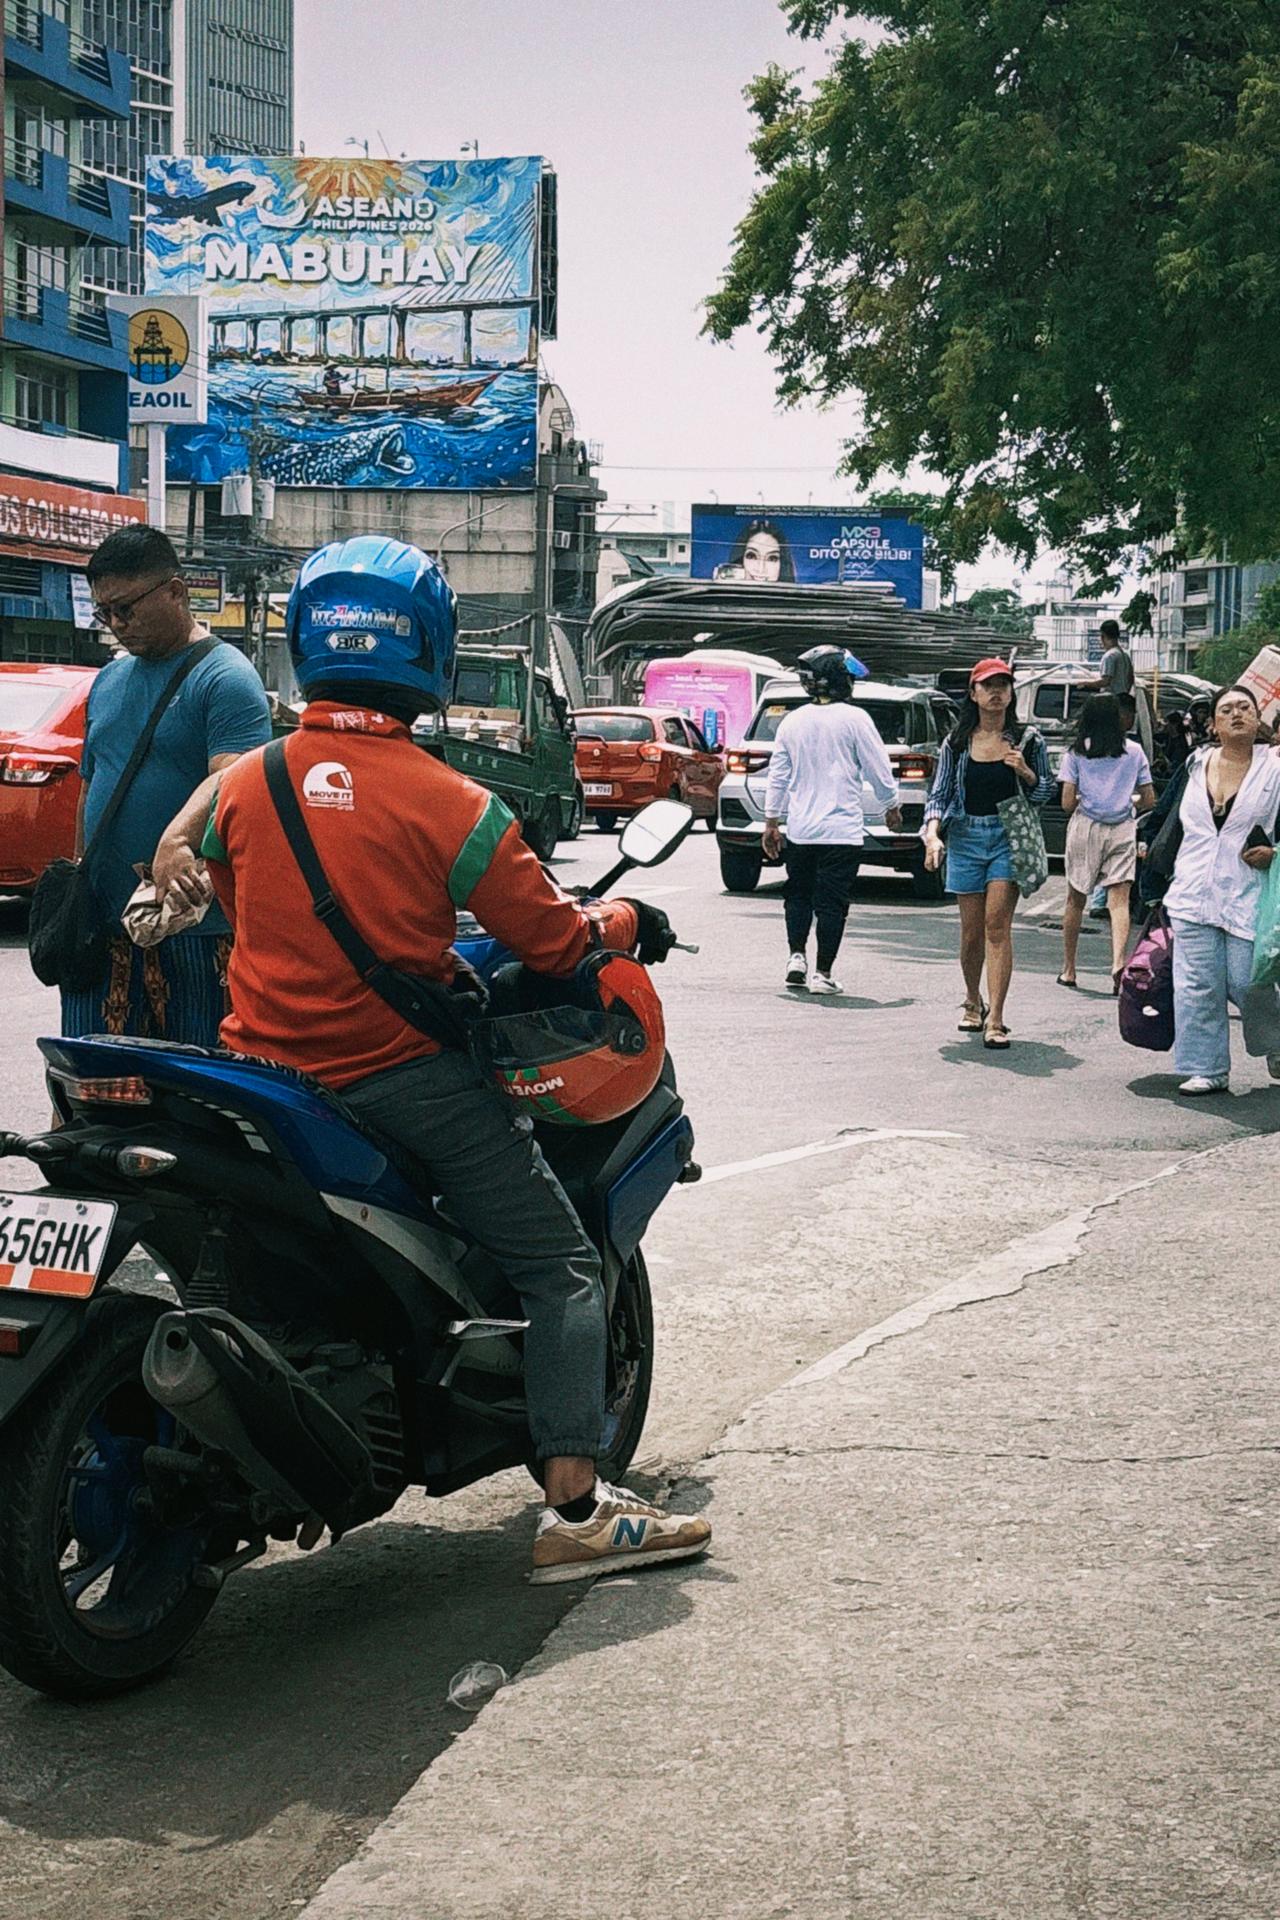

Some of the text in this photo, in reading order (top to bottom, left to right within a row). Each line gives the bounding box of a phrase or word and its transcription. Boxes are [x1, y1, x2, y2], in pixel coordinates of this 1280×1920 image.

[312, 220, 432, 232] PHILIPPINES 2026
[204, 241, 482, 284] MABUHAY
[841, 526, 881, 538] MX3
[831, 538, 890, 549] CAPSULE
[809, 549, 840, 559] DITO
[844, 550, 872, 560] AKO
[308, 790, 340, 799] MOVE
[512, 1075, 565, 1096] MOVE
[611, 1517, 648, 1548] N
